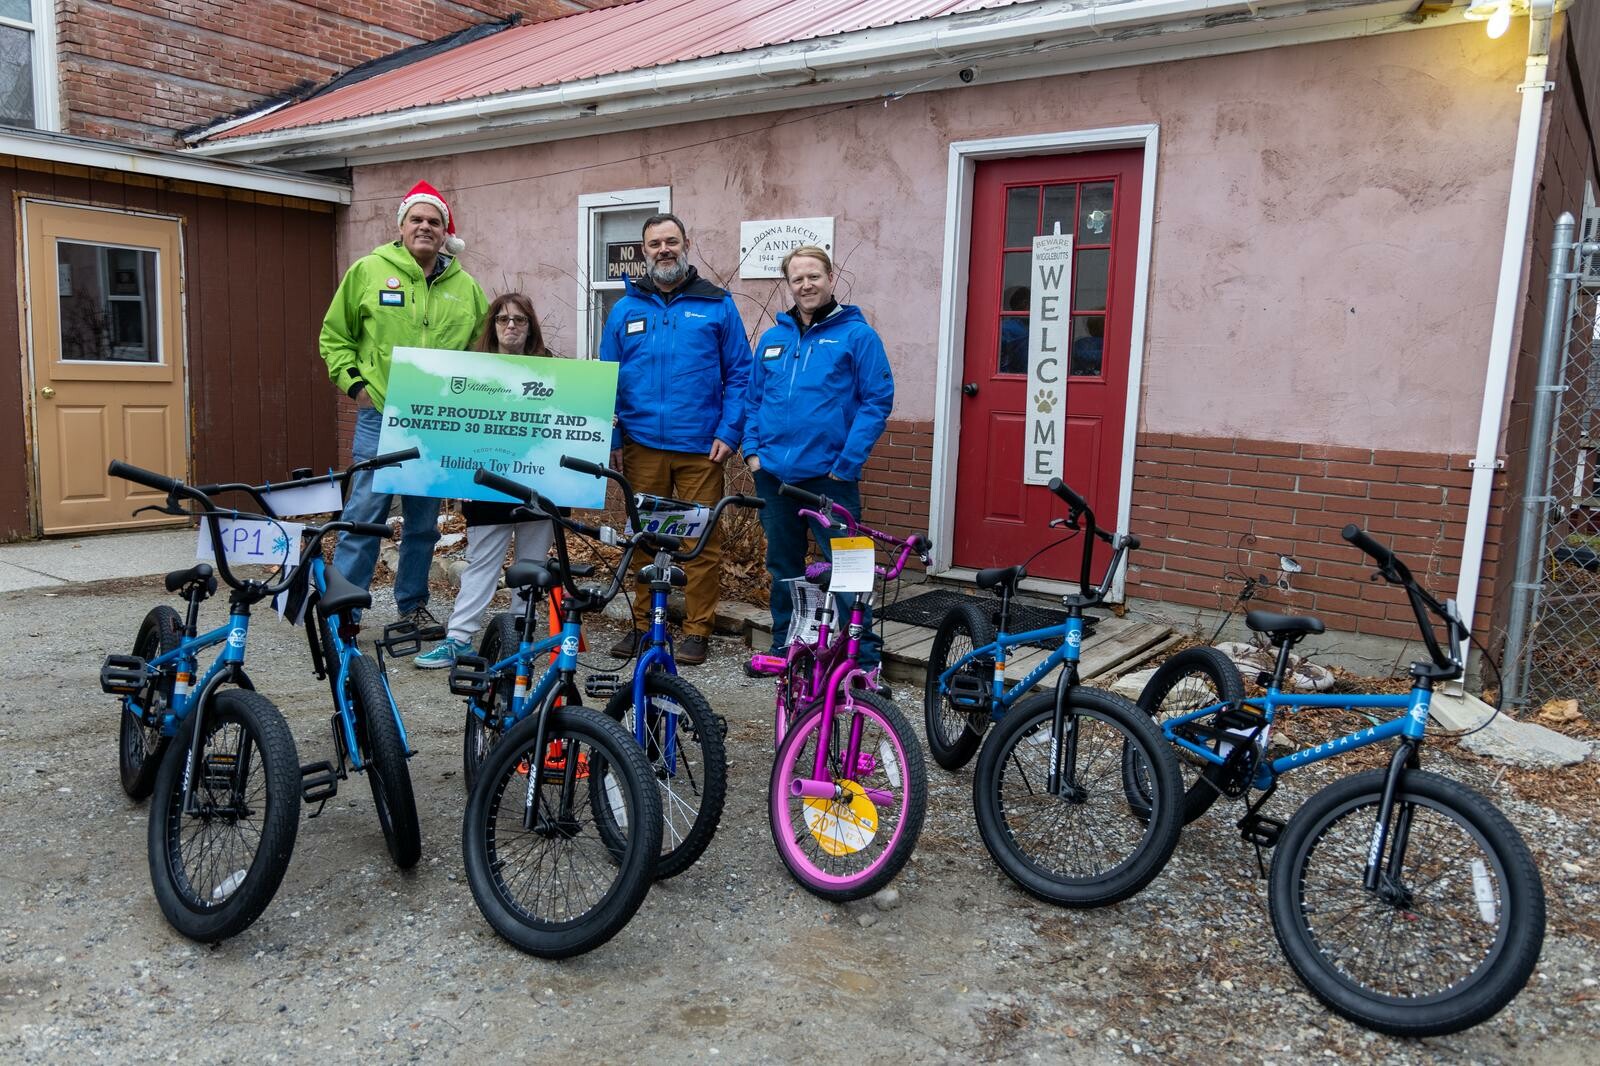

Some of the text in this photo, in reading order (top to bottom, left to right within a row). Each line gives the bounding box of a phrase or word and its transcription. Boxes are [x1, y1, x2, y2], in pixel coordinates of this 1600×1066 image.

[754, 225, 818, 243] DONNA BACCEI
[1036, 239, 1069, 248] BEWARE
[620, 246, 635, 260] NO
[759, 254, 774, 262] 1944
[609, 261, 647, 277] PARKING
[467, 381, 554, 397] Killington Pico
[411, 404, 587, 427] WE PROUDLY BUILT AND
[388, 417, 605, 443] DONATED 30 BIKES FOR KIDS.
[440, 455, 545, 476] Holiday Toy Drive
